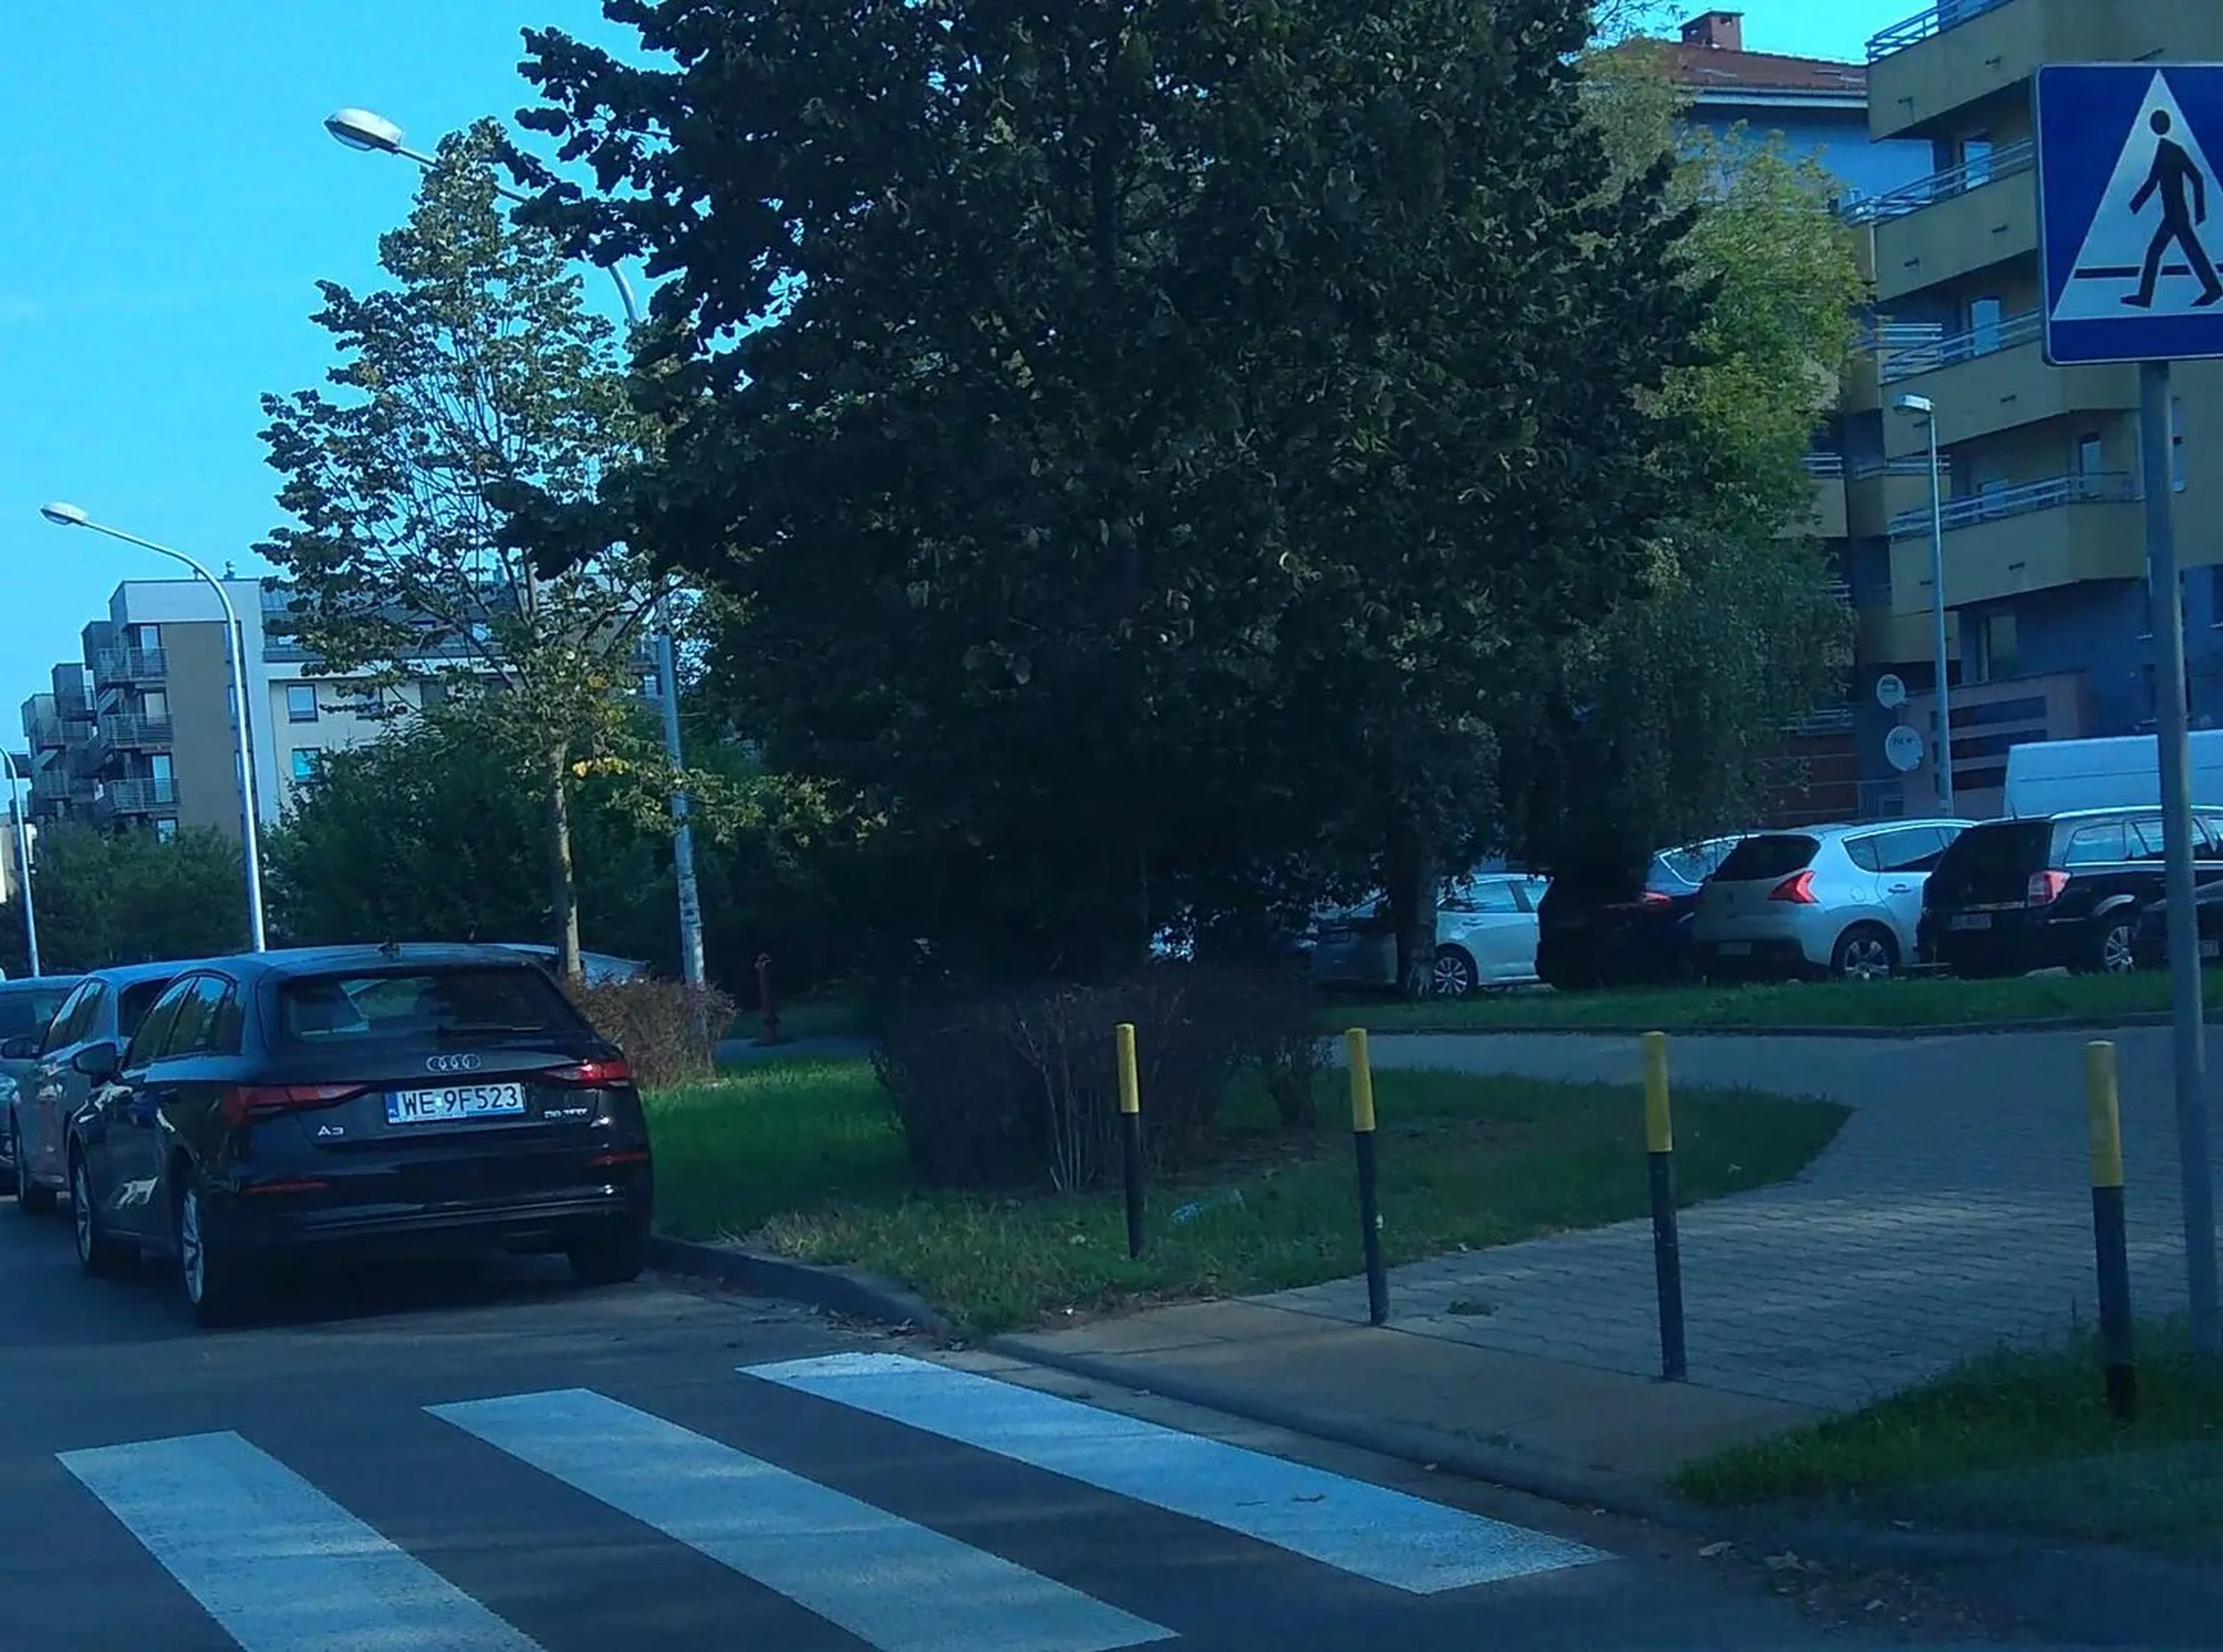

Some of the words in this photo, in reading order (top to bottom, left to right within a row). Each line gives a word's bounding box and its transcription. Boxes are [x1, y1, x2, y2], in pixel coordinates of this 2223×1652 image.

[402, 1092, 435, 1115] WE
[444, 1086, 518, 1111] 9F523
[317, 1125, 344, 1136] A3
